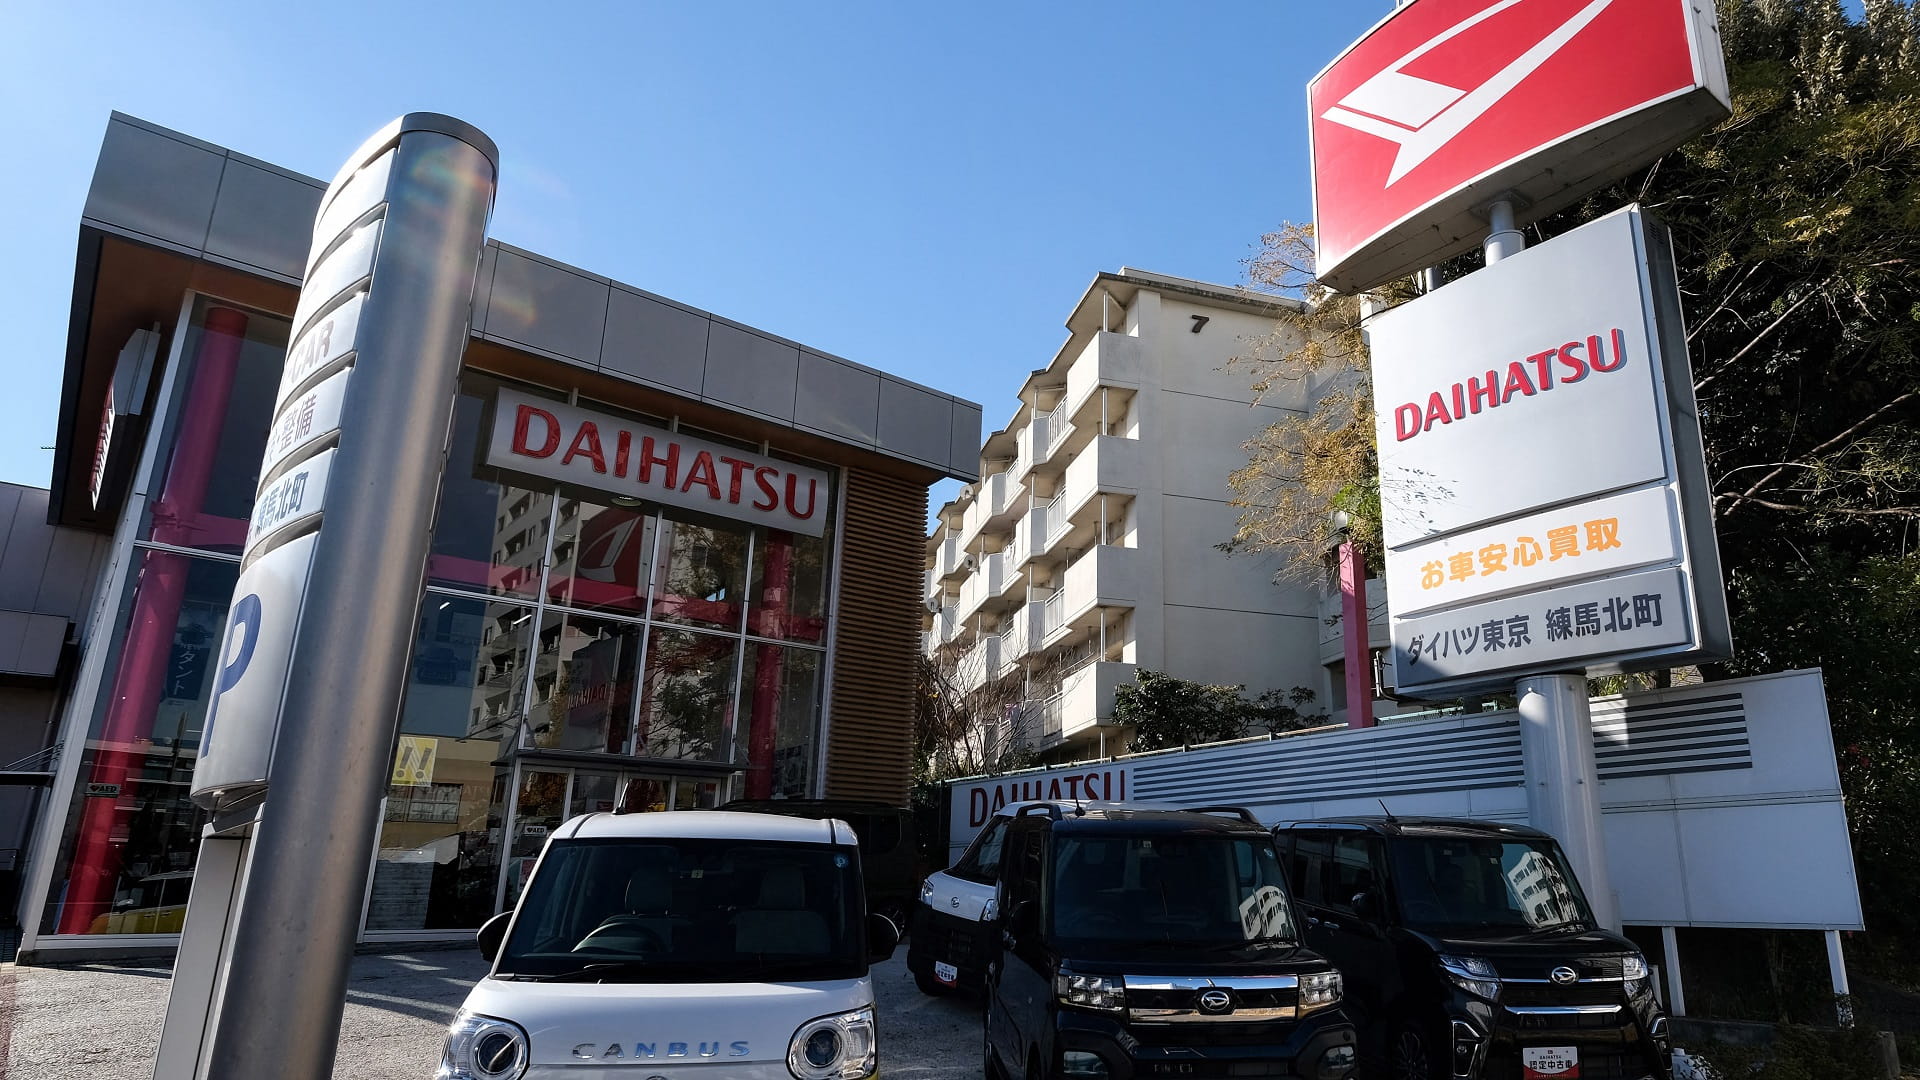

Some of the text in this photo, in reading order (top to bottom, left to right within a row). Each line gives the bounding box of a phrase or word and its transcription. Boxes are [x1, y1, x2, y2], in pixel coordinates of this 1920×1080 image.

[1191, 314, 1209, 333] 7
[1394, 328, 1629, 442] DAIHATSU
[510, 403, 818, 521] DAIHATSU
[1420, 517, 1623, 591] お車安心買取
[1407, 593, 1664, 666] ダイハツ東京 練馬北町
[173, 650, 195, 695] タント
[200, 593, 262, 759] P
[99, 785, 117, 793] AED
[573, 1041, 751, 1059] CANBUS
[1529, 1059, 1573, 1070] 認定中古車
